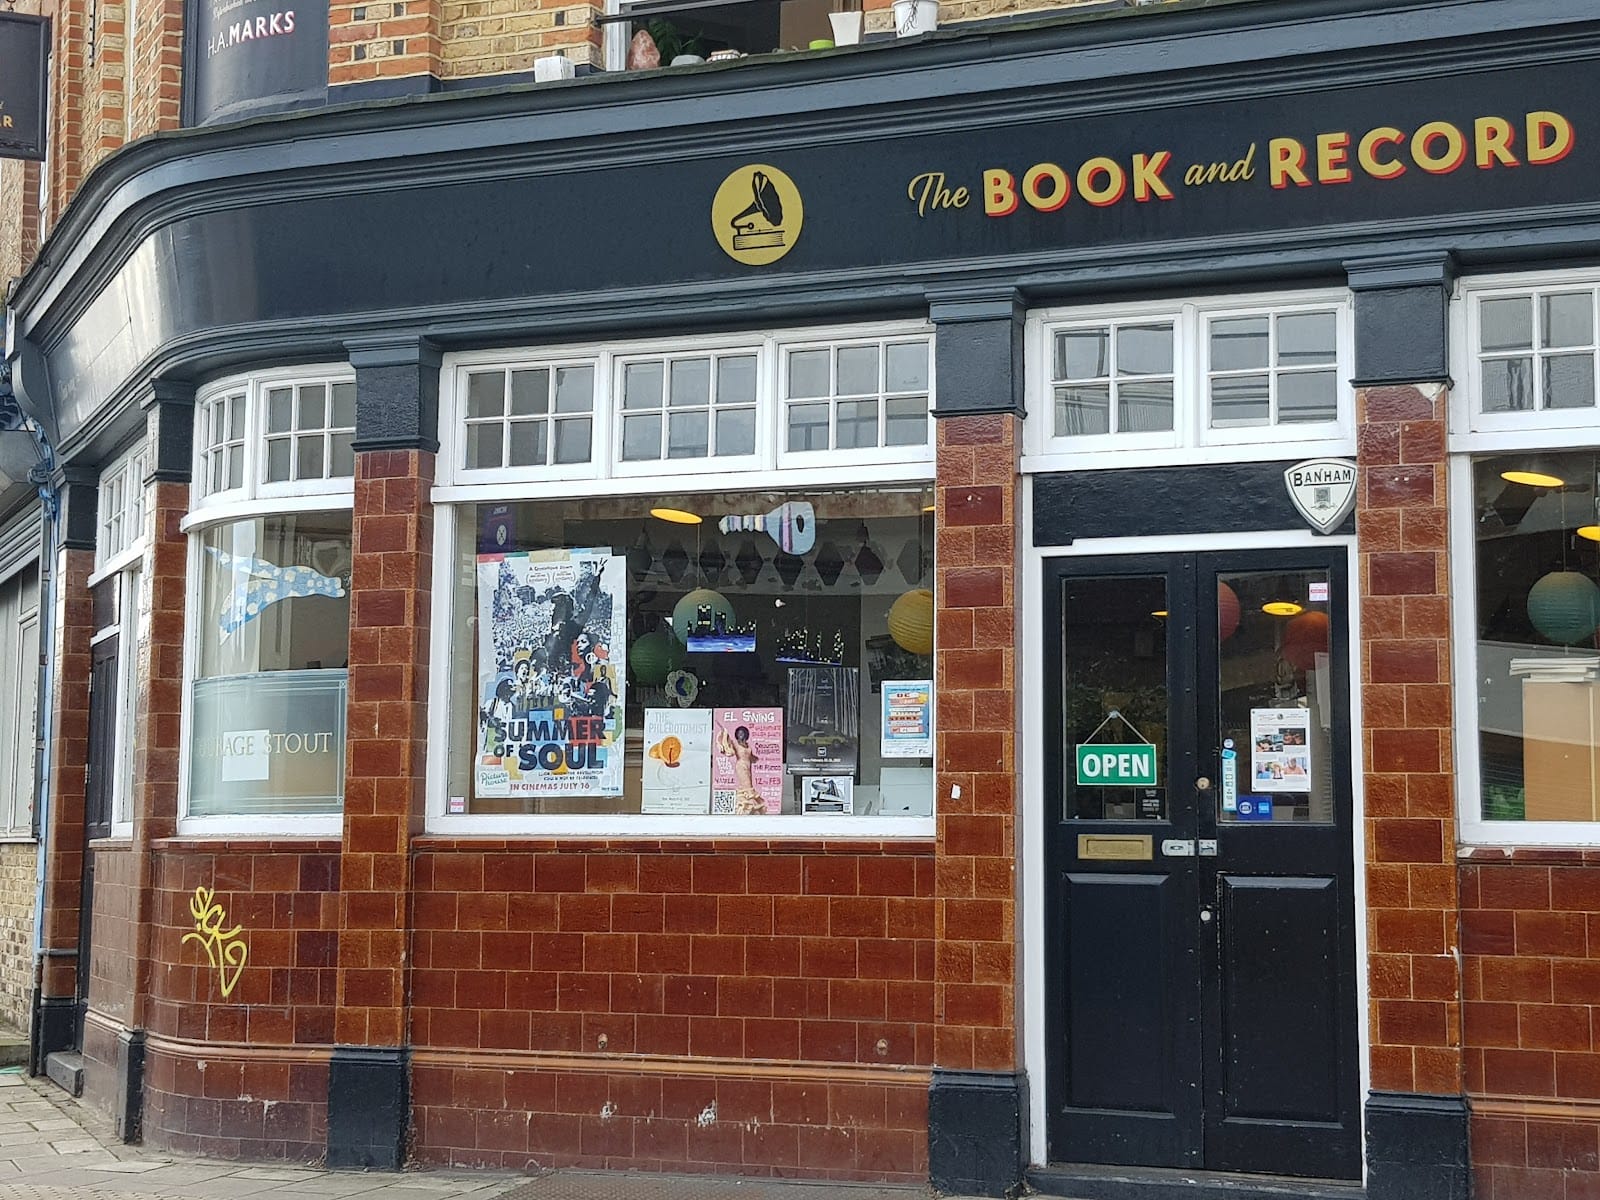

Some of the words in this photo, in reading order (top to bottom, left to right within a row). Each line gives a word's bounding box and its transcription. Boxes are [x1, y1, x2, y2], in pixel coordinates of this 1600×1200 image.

[907, 172, 969, 218] The
[983, 151, 1175, 217] BOOK
[1184, 142, 1256, 190] and
[1269, 110, 1574, 190] RECORD
[1294, 470, 1351, 487] BANHAM
[724, 712, 738, 722] EL
[494, 717, 606, 742] SUMMER
[263, 732, 333, 755] STOUT
[493, 744, 514, 758] OF
[518, 742, 604, 771] SOUL
[1082, 753, 1150, 778] OPEN
[521, 782, 558, 791] CINEMAS
[560, 782, 578, 790] JULY
